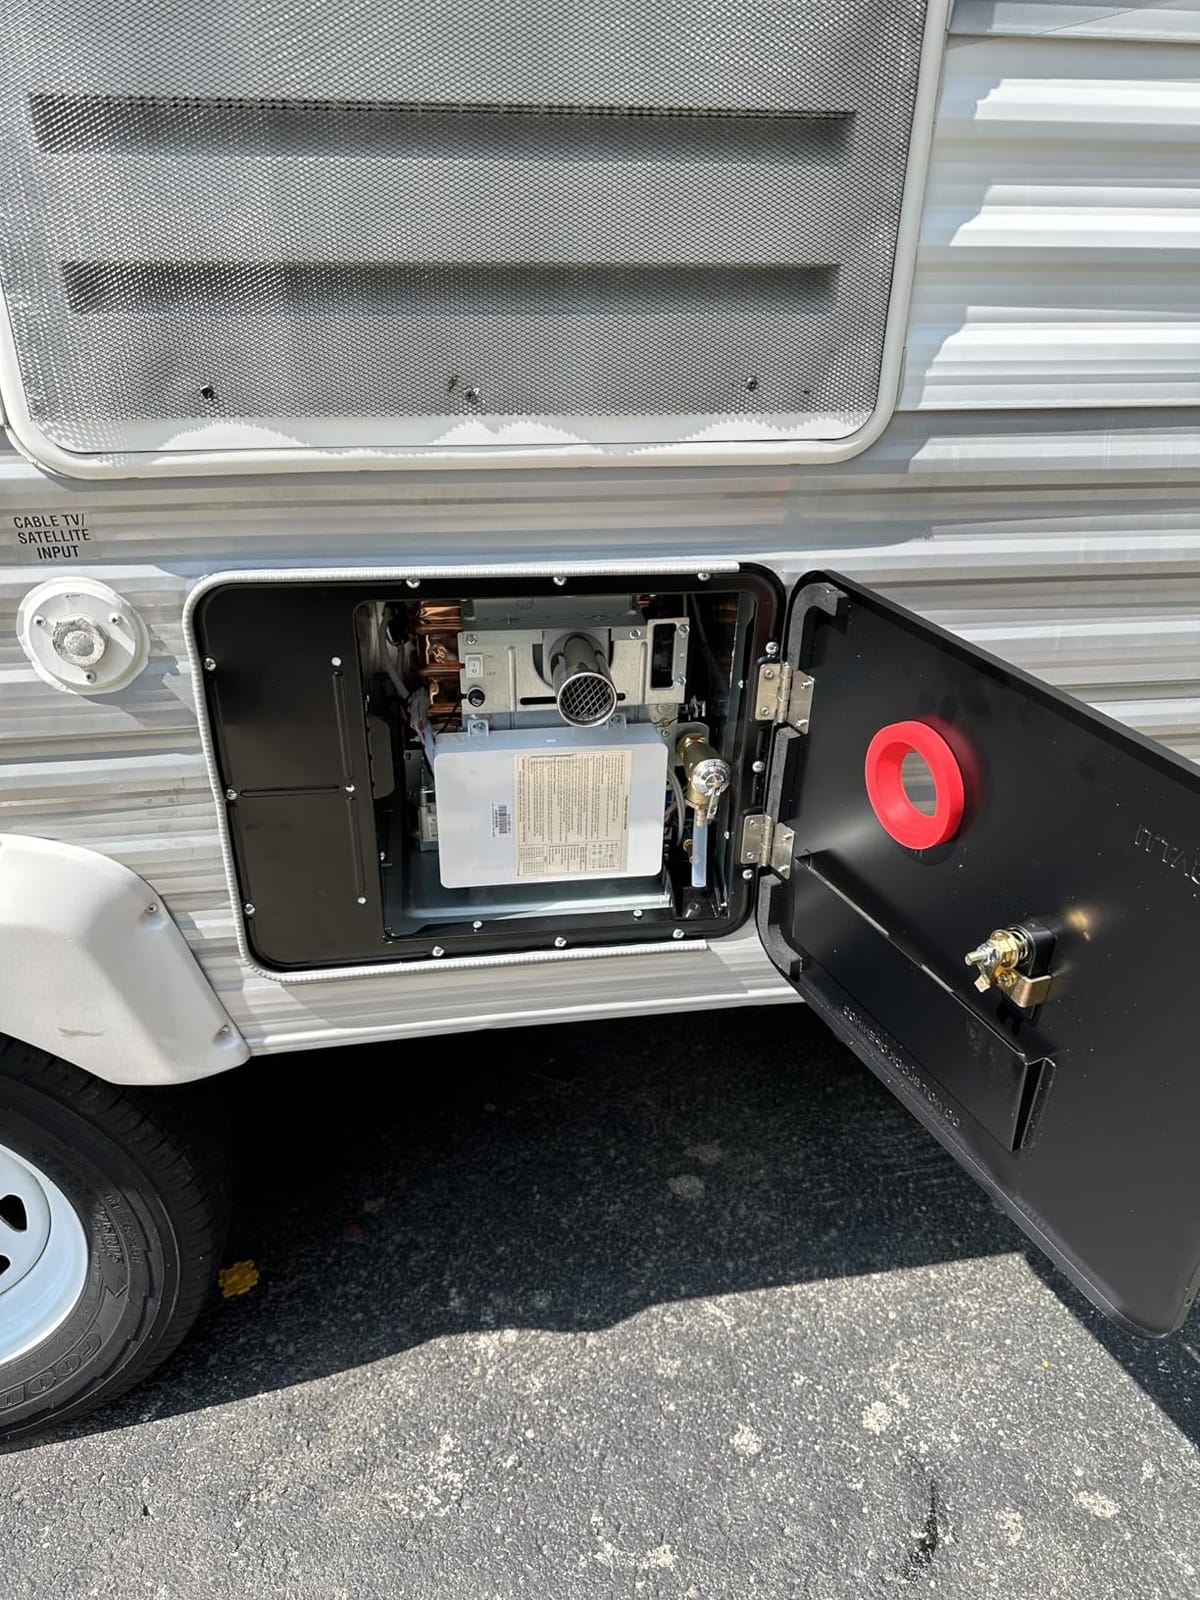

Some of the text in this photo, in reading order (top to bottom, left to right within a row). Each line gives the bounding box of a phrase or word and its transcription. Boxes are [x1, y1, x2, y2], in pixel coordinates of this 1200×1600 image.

[13, 513, 85, 529] CABLE TV/
[17, 528, 92, 544] SATELLITE
[36, 544, 79, 560] INPUT
